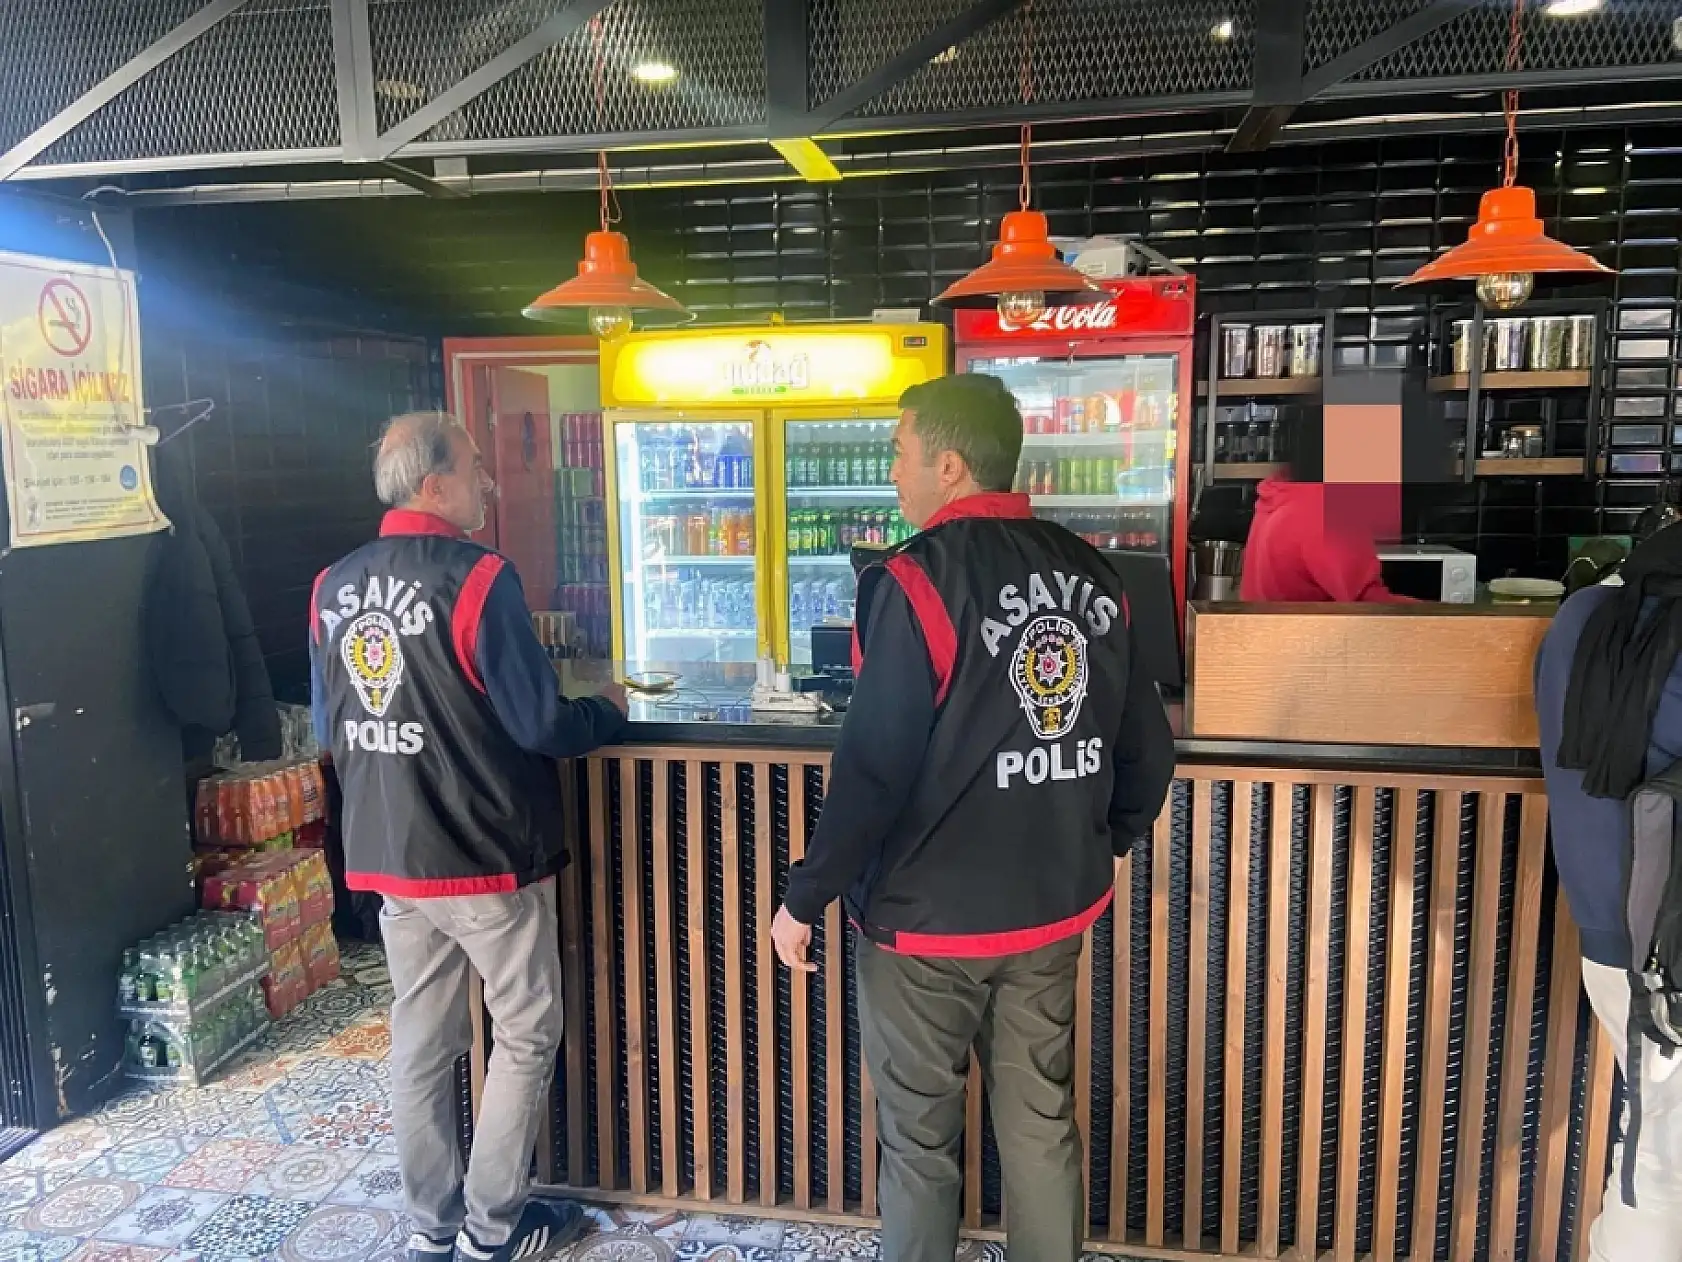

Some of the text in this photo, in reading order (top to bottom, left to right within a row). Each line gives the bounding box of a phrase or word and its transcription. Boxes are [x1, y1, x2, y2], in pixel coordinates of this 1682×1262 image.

[998, 290, 1122, 331] C-Cola
[10, 358, 69, 401] SİGARA
[344, 720, 424, 755] POLİS
[997, 737, 1102, 788] POLİS
